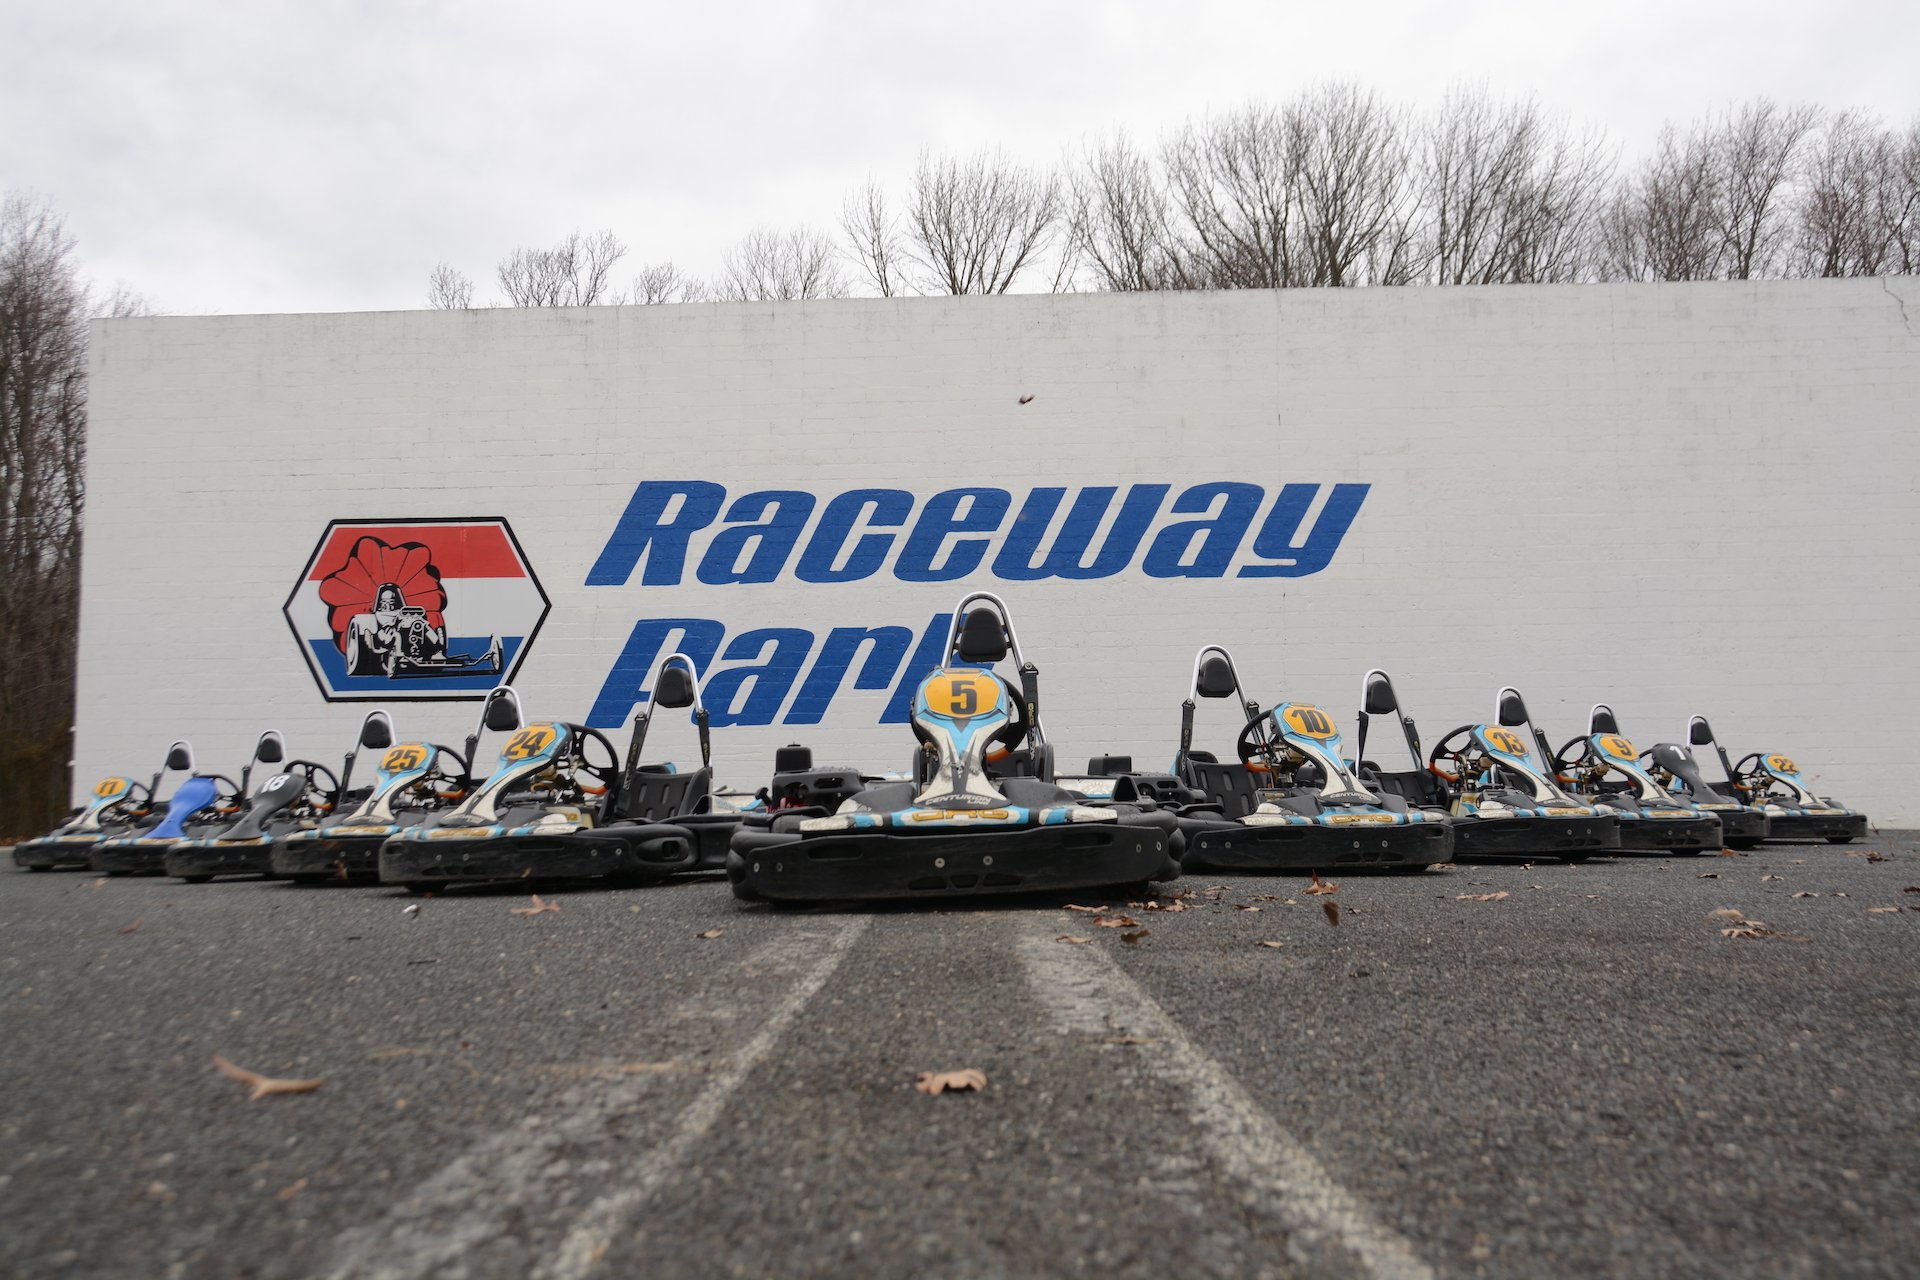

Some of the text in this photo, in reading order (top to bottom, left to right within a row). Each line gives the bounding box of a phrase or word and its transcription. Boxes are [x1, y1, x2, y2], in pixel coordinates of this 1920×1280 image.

[585, 480, 1369, 586] Raceway
[950, 680, 978, 715] 5
[1291, 709, 1331, 734] 10
[504, 730, 548, 758] 24
[1493, 731, 1526, 754] 13
[1611, 738, 1633, 756] 9
[384, 748, 420, 771] 25
[261, 774, 289, 794] 18
